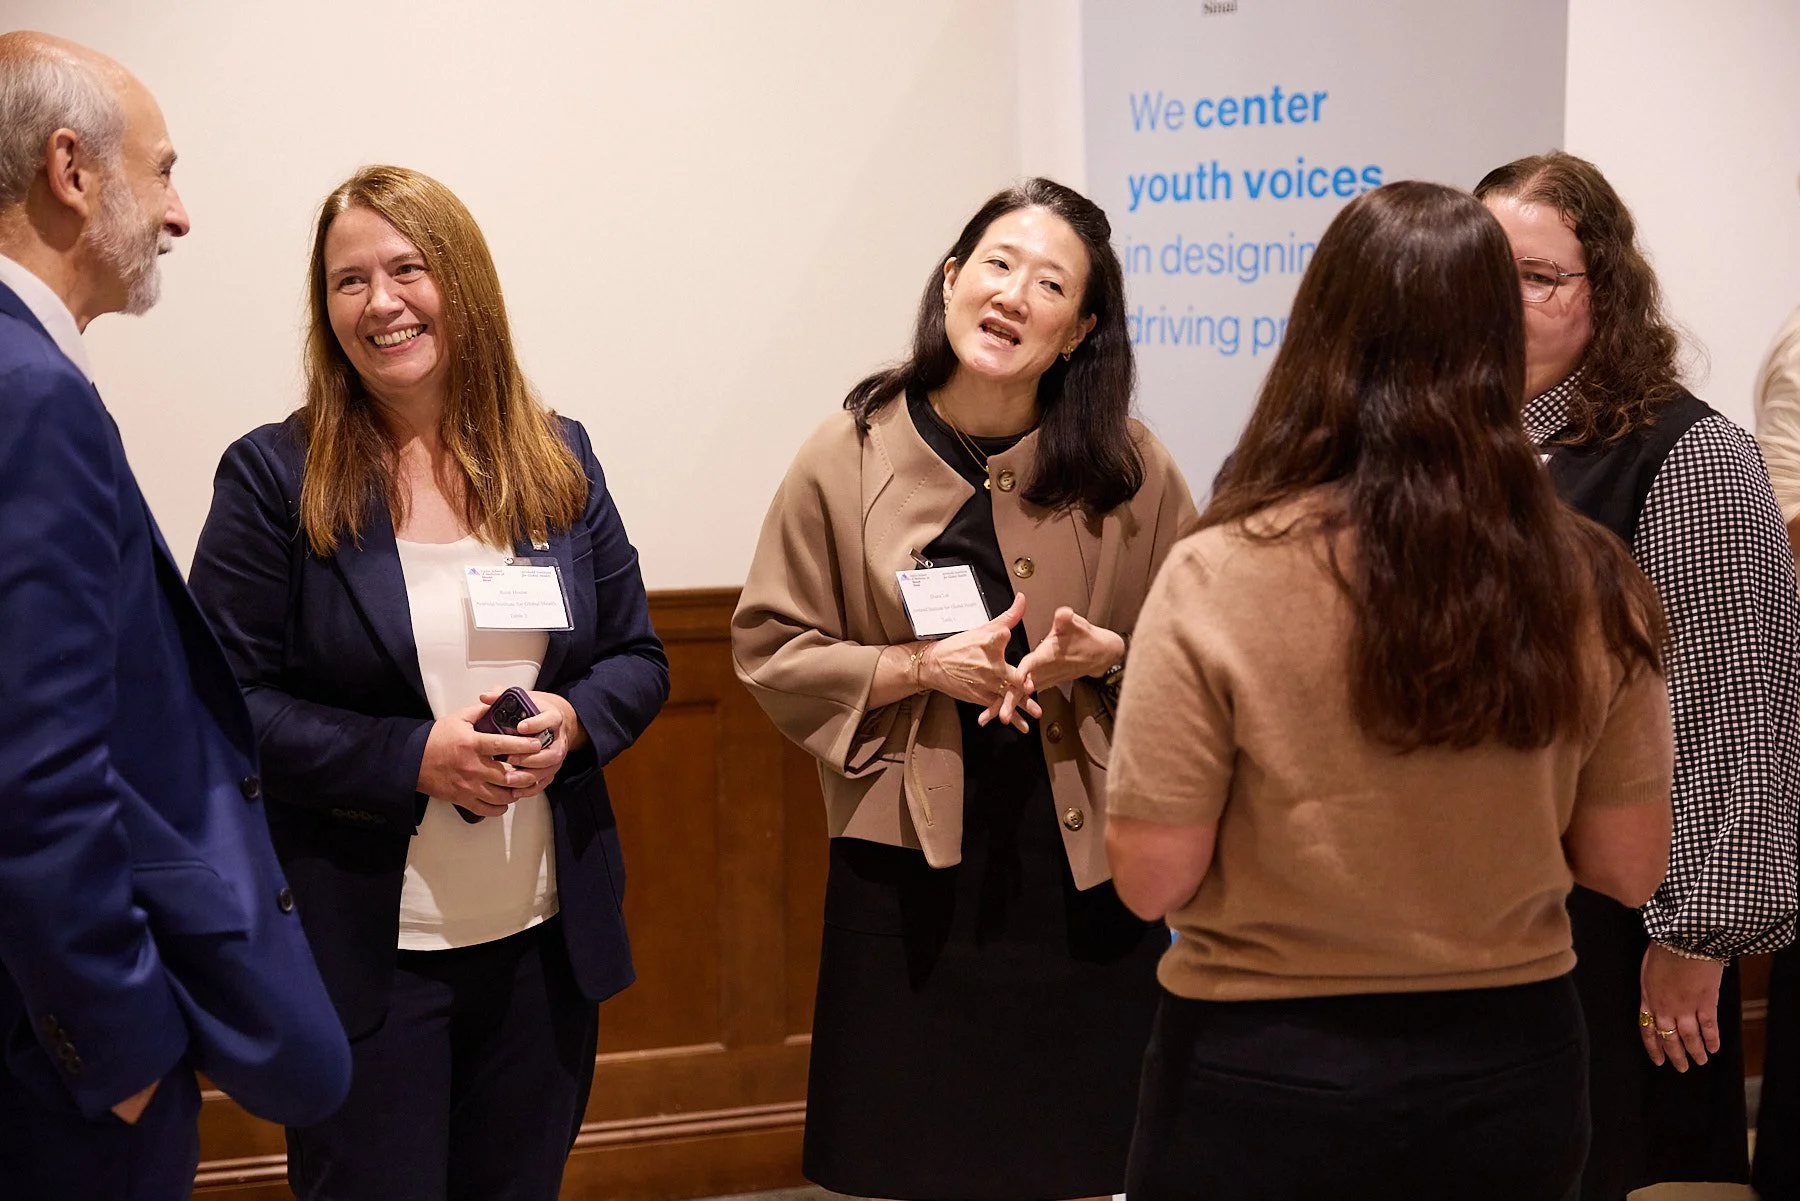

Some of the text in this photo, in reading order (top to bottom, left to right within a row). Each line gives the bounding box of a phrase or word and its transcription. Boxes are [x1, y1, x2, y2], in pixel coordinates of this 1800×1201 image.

[1128, 84, 1329, 132] We center
[1127, 155, 1384, 213] youth voices
[1124, 232, 1318, 284] in designin
[1125, 304, 1241, 357] driving
